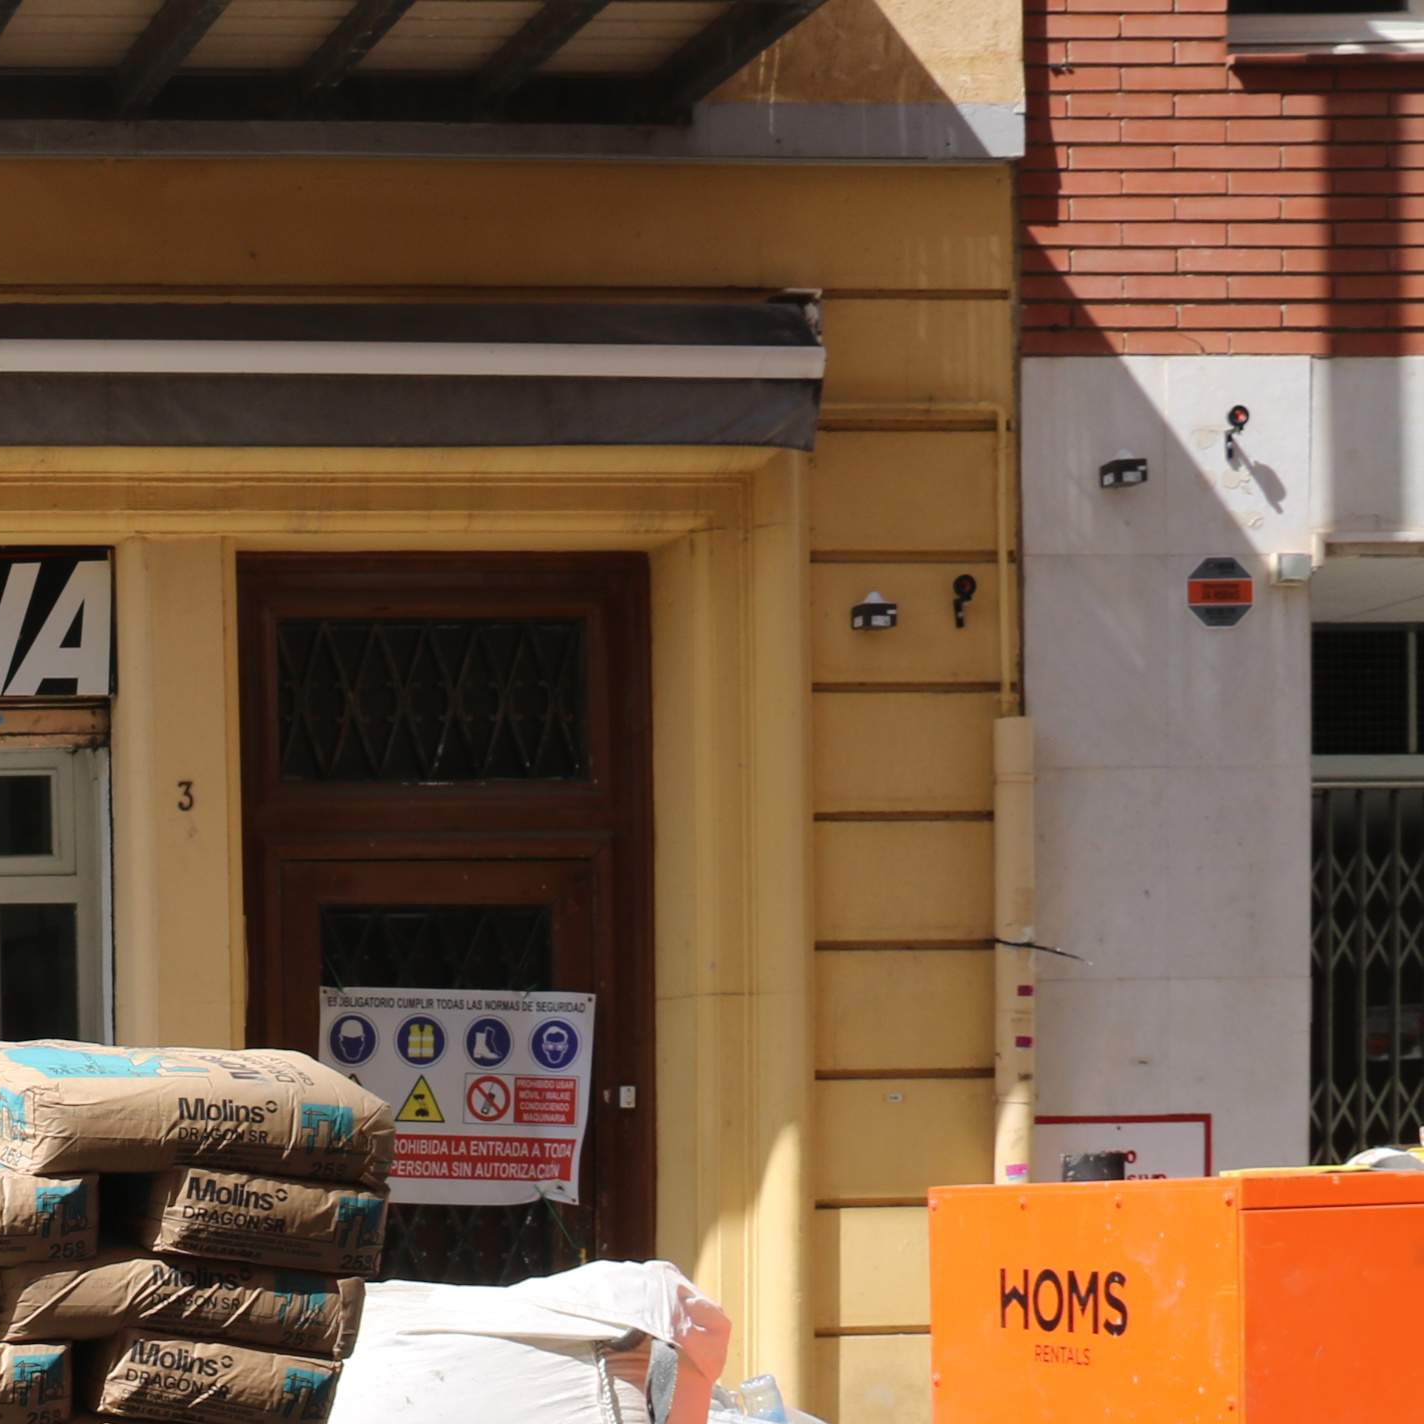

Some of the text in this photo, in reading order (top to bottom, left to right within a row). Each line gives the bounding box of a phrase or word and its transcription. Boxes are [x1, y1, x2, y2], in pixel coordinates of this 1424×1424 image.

[176, 781, 196, 812] 3
[338, 996, 395, 1009] OBLIGATORIO
[397, 997, 434, 1009] CUMPLIR
[436, 998, 465, 1011] TODAS
[467, 999, 483, 1011] LAS
[484, 1000, 521, 1013] NORMAS
[522, 1001, 533, 1012] DE
[535, 1001, 586, 1014] SEGURIDAD
[178, 1097, 265, 1124] Molins
[178, 1126, 269, 1144] DRAGON SR
[393, 1139, 572, 1158] ROHIBIDA LA ENTRADA A TODA
[391, 1161, 449, 1176] PERSONA
[451, 1162, 473, 1177] SIN
[186, 1176, 276, 1211] Molins
[182, 1205, 286, 1233] DRAGON SR
[151, 1263, 238, 1290] Molins
[222, 1297, 241, 1310] SR
[998, 1267, 1128, 1337] HOMS
[130, 1339, 219, 1377] Molins
[1033, 1344, 1091, 1366] RENTALS
[125, 1368, 204, 1394] DRAGON
